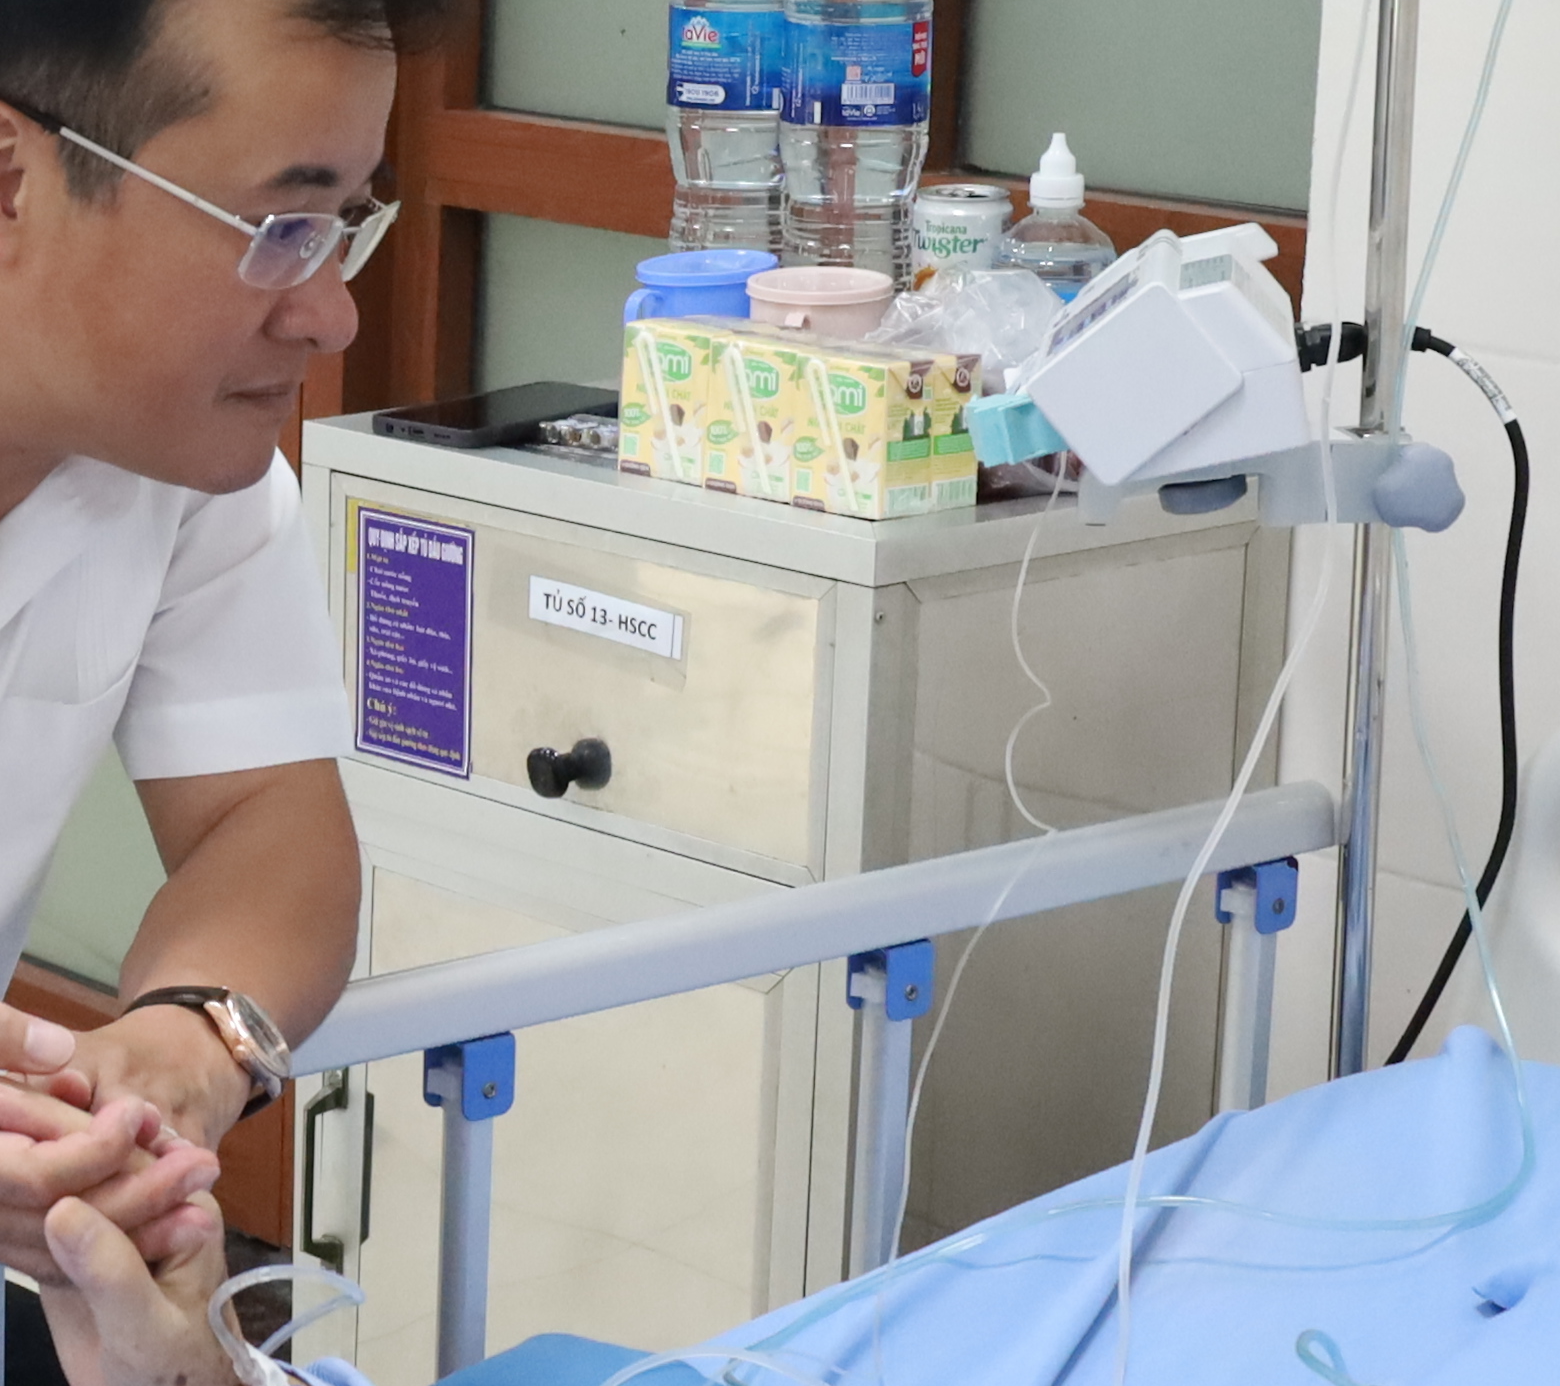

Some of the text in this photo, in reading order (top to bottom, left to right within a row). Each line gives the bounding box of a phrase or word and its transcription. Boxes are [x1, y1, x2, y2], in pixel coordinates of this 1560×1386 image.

[912, 227, 986, 259] Twister
[925, 219, 968, 235] Tropicana
[543, 589, 657, 640] TỦ SỐ 13- HSCC
